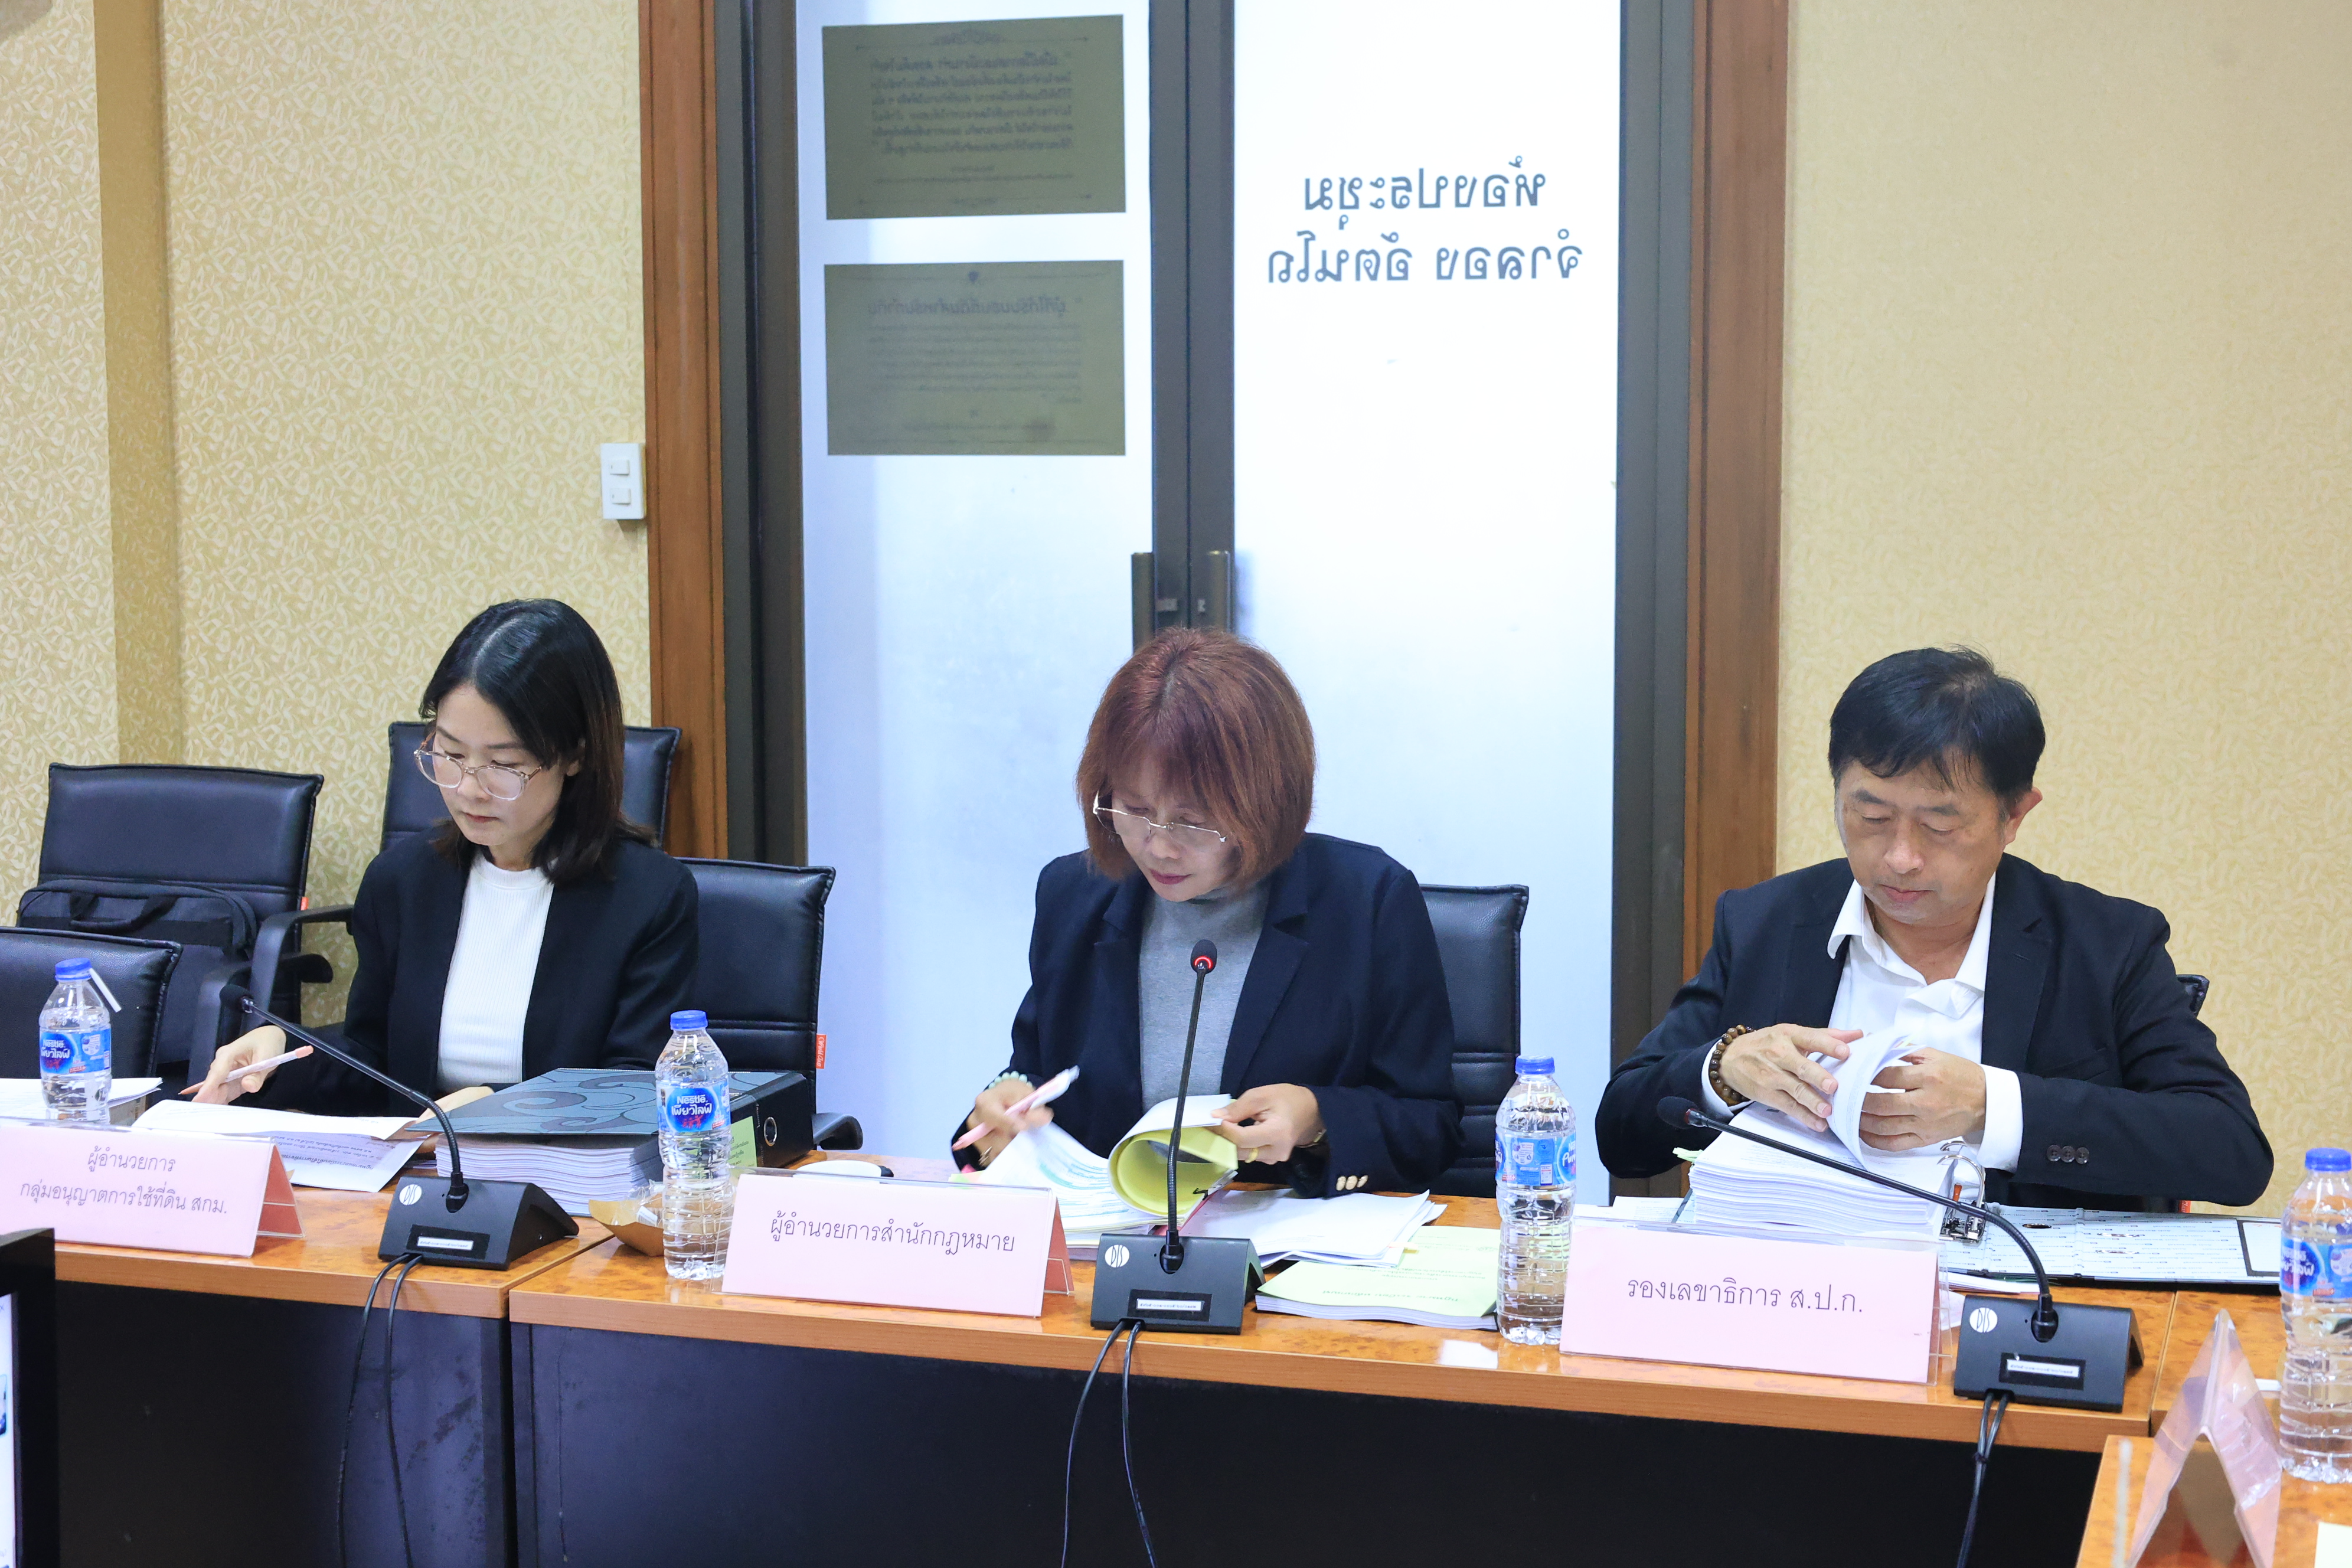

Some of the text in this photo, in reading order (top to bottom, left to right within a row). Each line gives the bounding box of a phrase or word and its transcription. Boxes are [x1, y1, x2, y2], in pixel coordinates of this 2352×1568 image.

[671, 1103, 713, 1116] เพียวไลฟ์
[677, 1095, 706, 1105] Nestlé
[87, 1145, 176, 1173] ผู้อำนวยการ
[20, 1179, 228, 1214] กลุ่มอนุญาตการใช้ที่ดิน สกม.
[770, 1210, 1015, 1256] ผู้อำนวยการสำนักกฎหมาย
[1628, 1277, 1863, 1313] รองเลขาธิการ ส.ป.ก.
